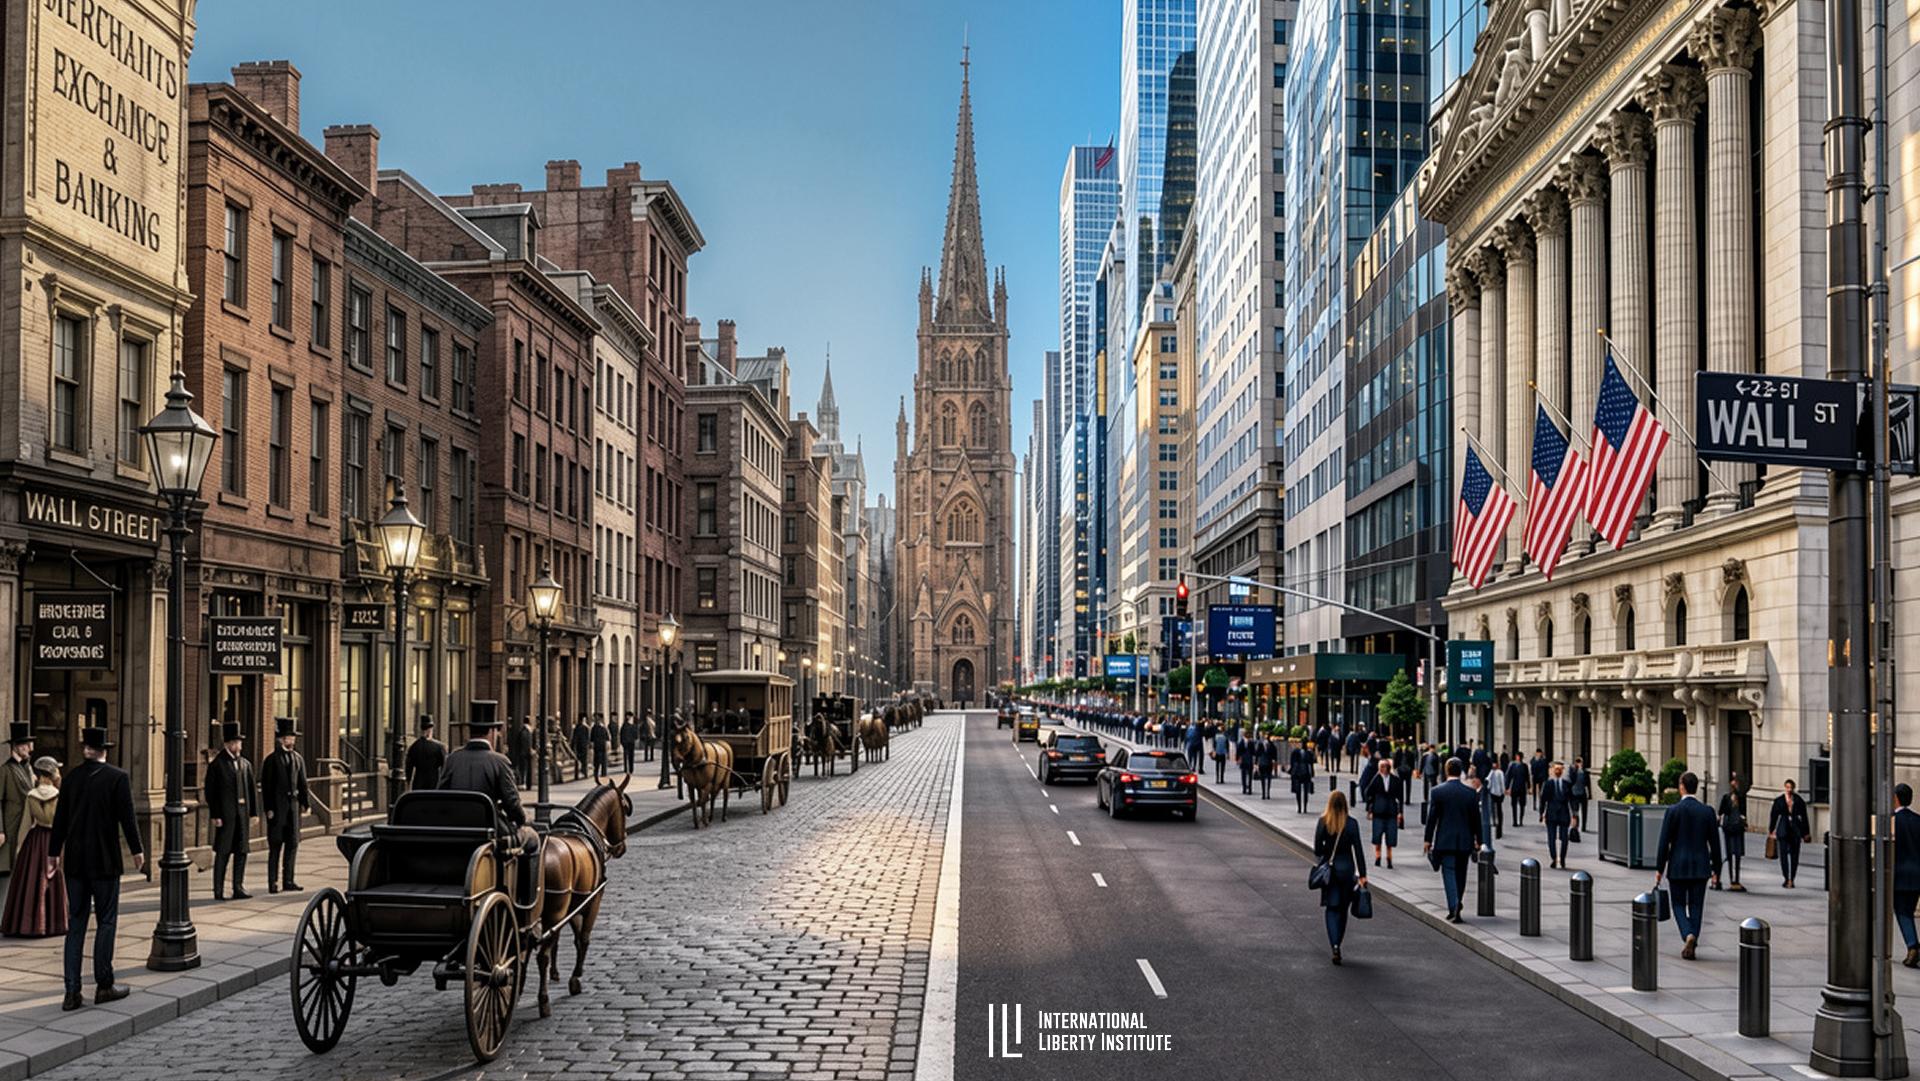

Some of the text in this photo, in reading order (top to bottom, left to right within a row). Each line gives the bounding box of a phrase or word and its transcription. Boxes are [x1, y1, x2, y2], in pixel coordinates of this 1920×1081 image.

[103, 137, 118, 175] &
[55, 158, 160, 252] BANKING
[1707, 399, 1839, 449] WALL ST
[25, 491, 160, 542] WALL STREET
